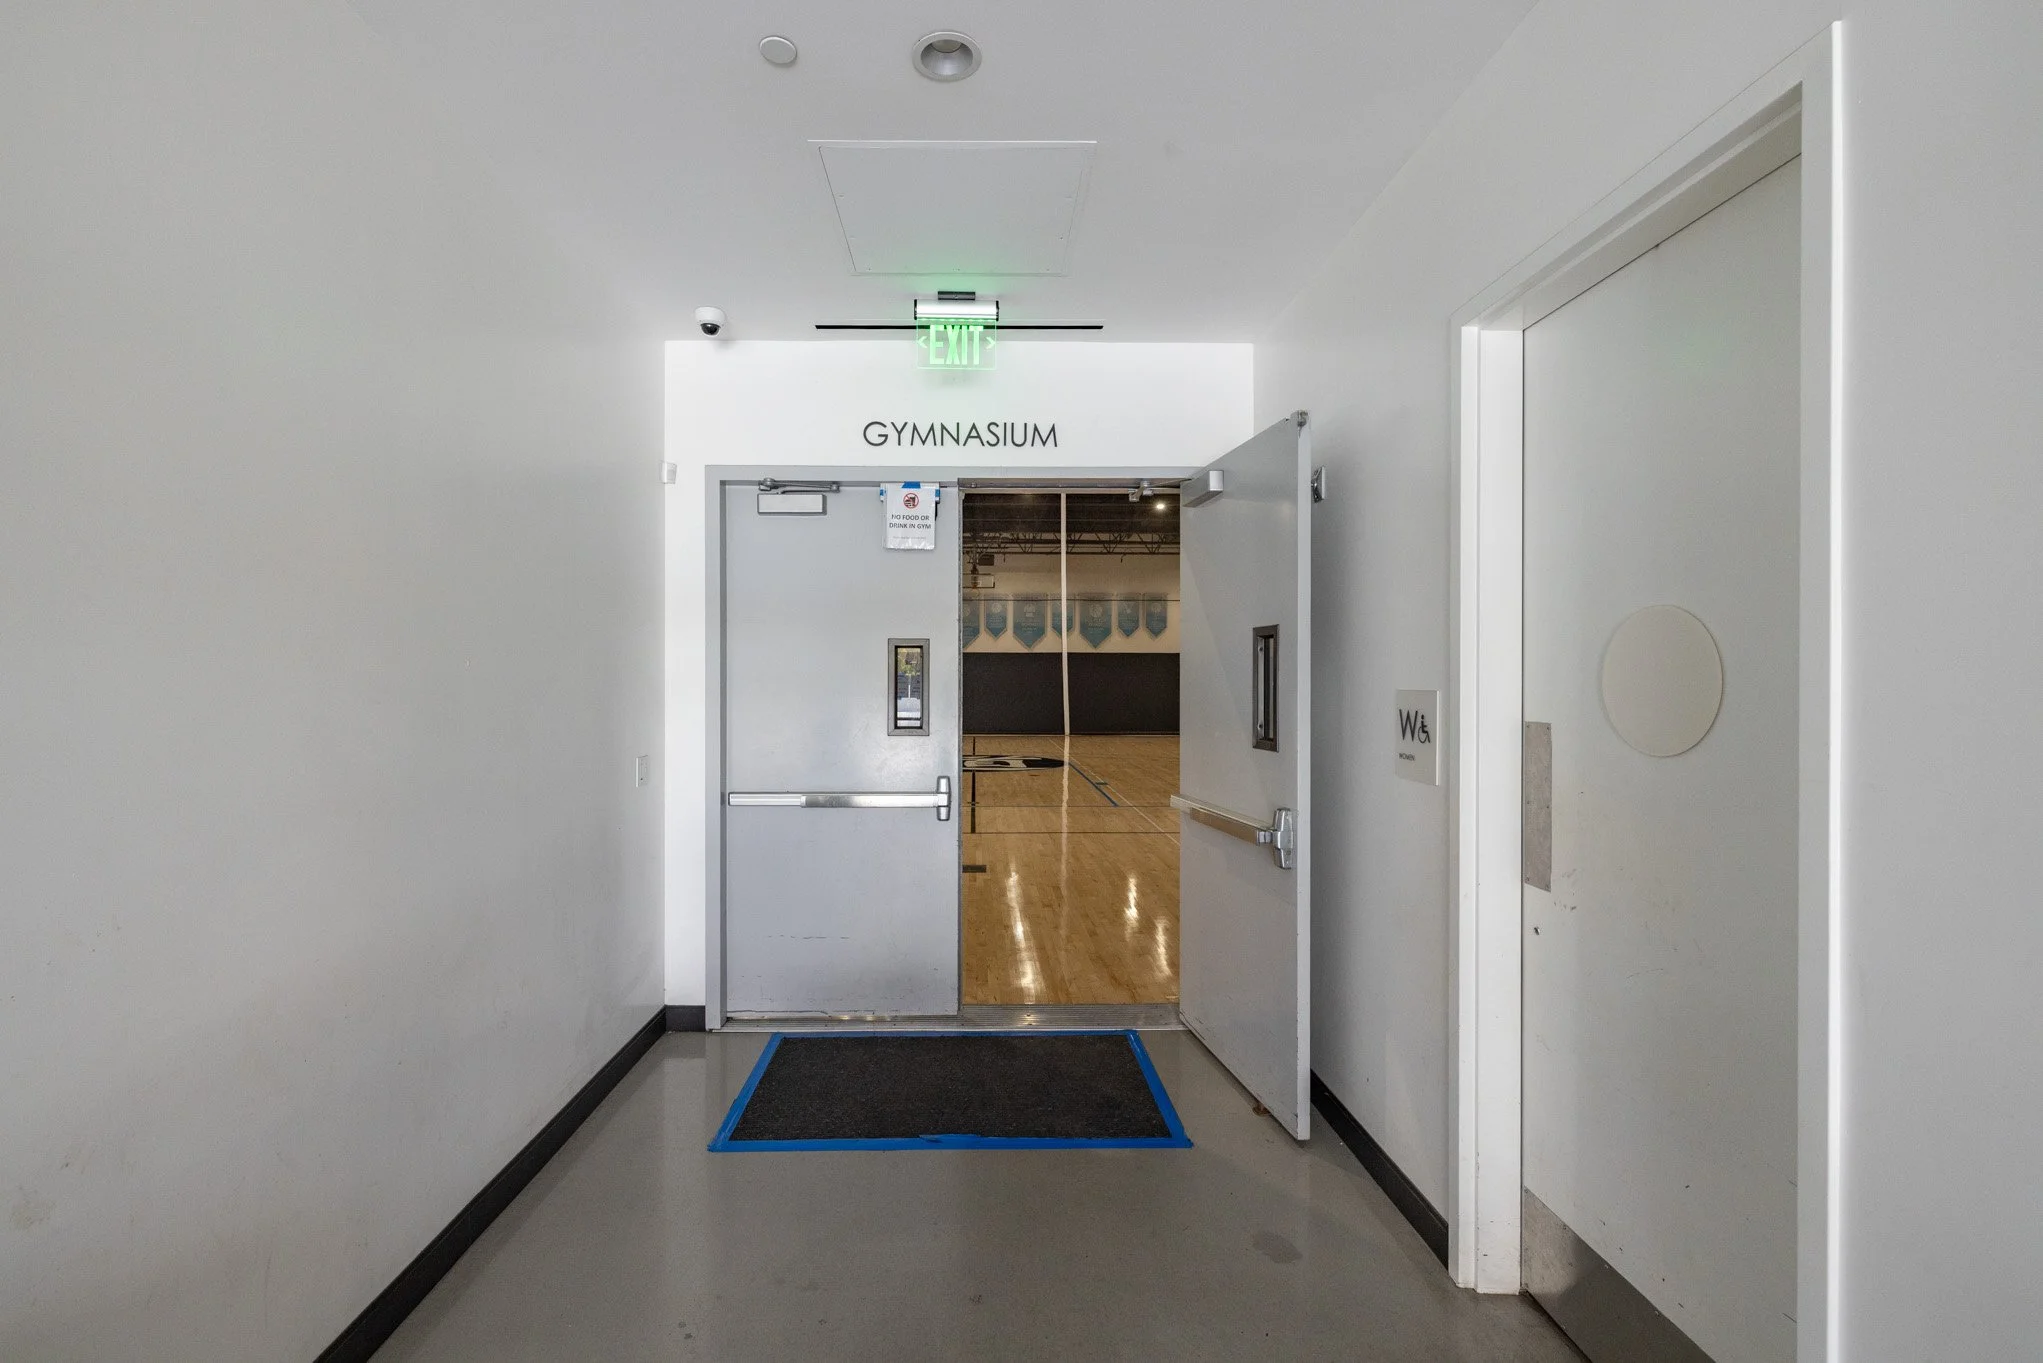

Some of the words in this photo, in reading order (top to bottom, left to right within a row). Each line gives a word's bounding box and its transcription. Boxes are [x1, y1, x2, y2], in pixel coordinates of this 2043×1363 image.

[929, 324, 984, 365] EXIT
[863, 421, 1058, 448] GYMNASIUM
[1399, 708, 1418, 742] W
